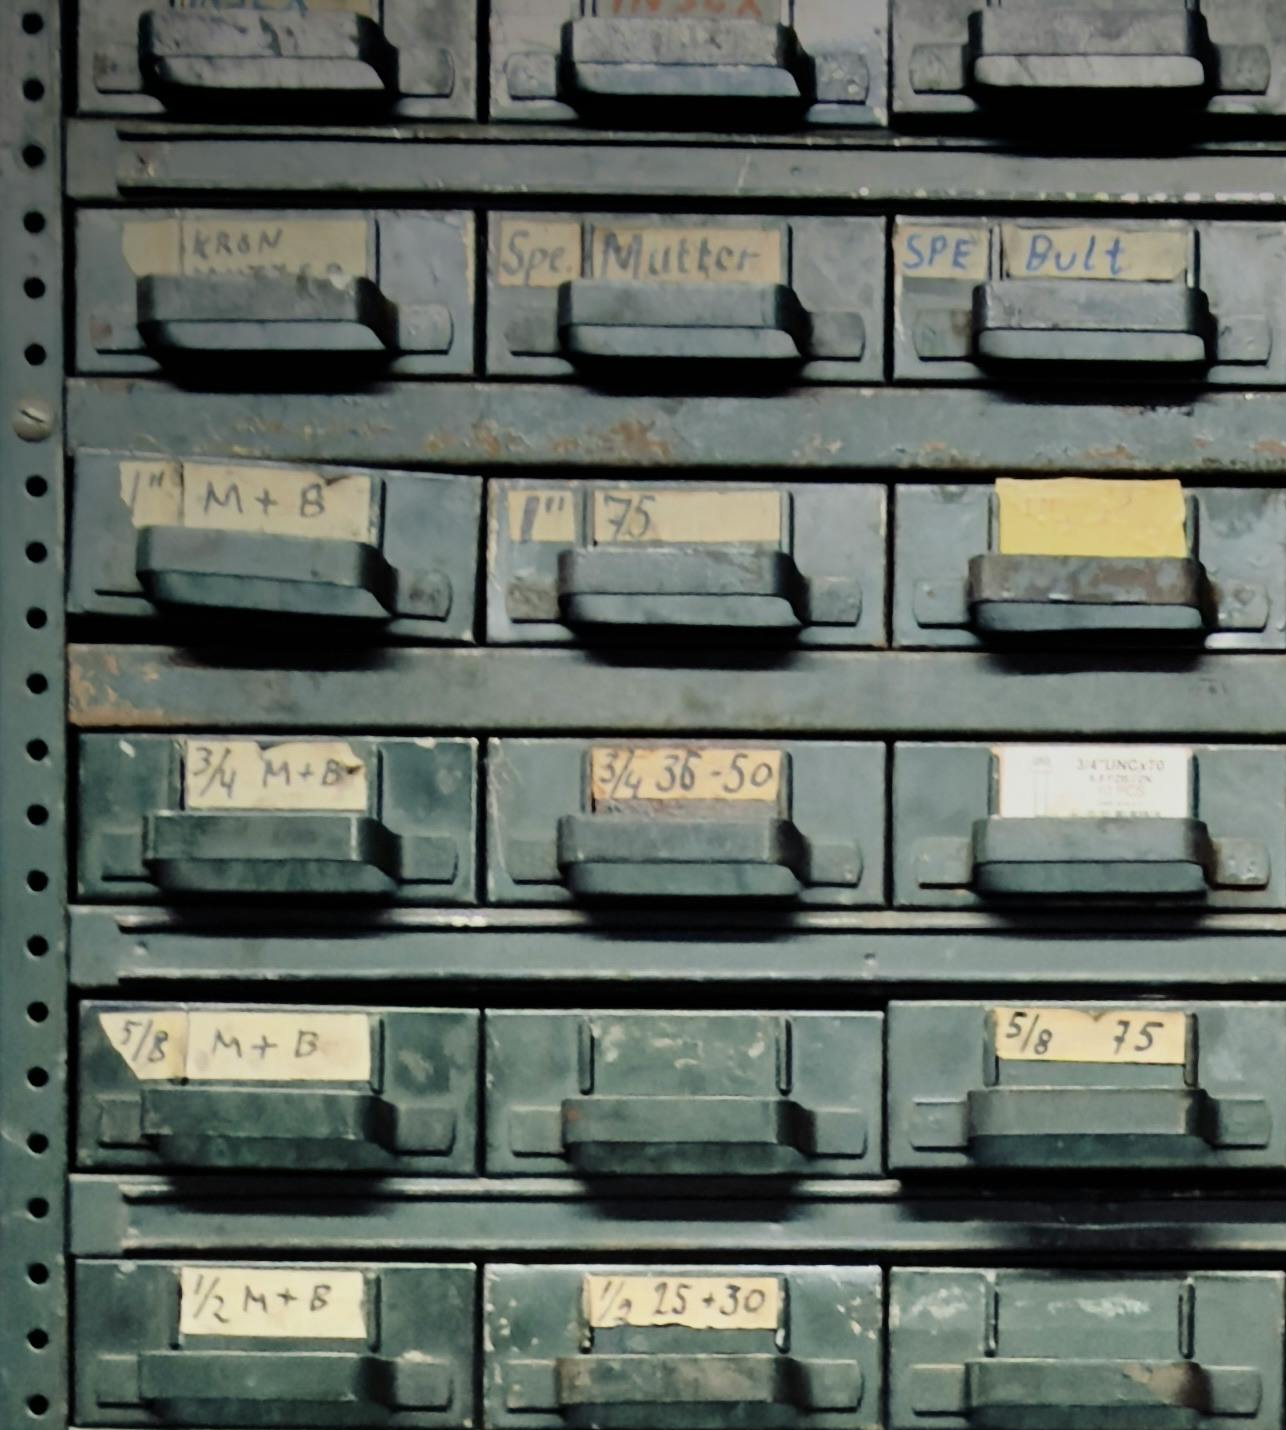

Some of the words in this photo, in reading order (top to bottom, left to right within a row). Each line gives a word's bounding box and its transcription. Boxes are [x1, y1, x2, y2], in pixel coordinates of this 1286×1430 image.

[604, 232, 760, 274] Mutter
[904, 238, 975, 271] SPE
[1027, 236, 1126, 275] Bult
[602, 490, 652, 540] 75
[193, 747, 237, 796] 3/4
[600, 752, 644, 798] 3/4
[1007, 1012, 1051, 1056] 5/8
[1113, 1022, 1164, 1051] 75
[193, 1276, 226, 1324] 1/2
[600, 1282, 631, 1325] 1/2
